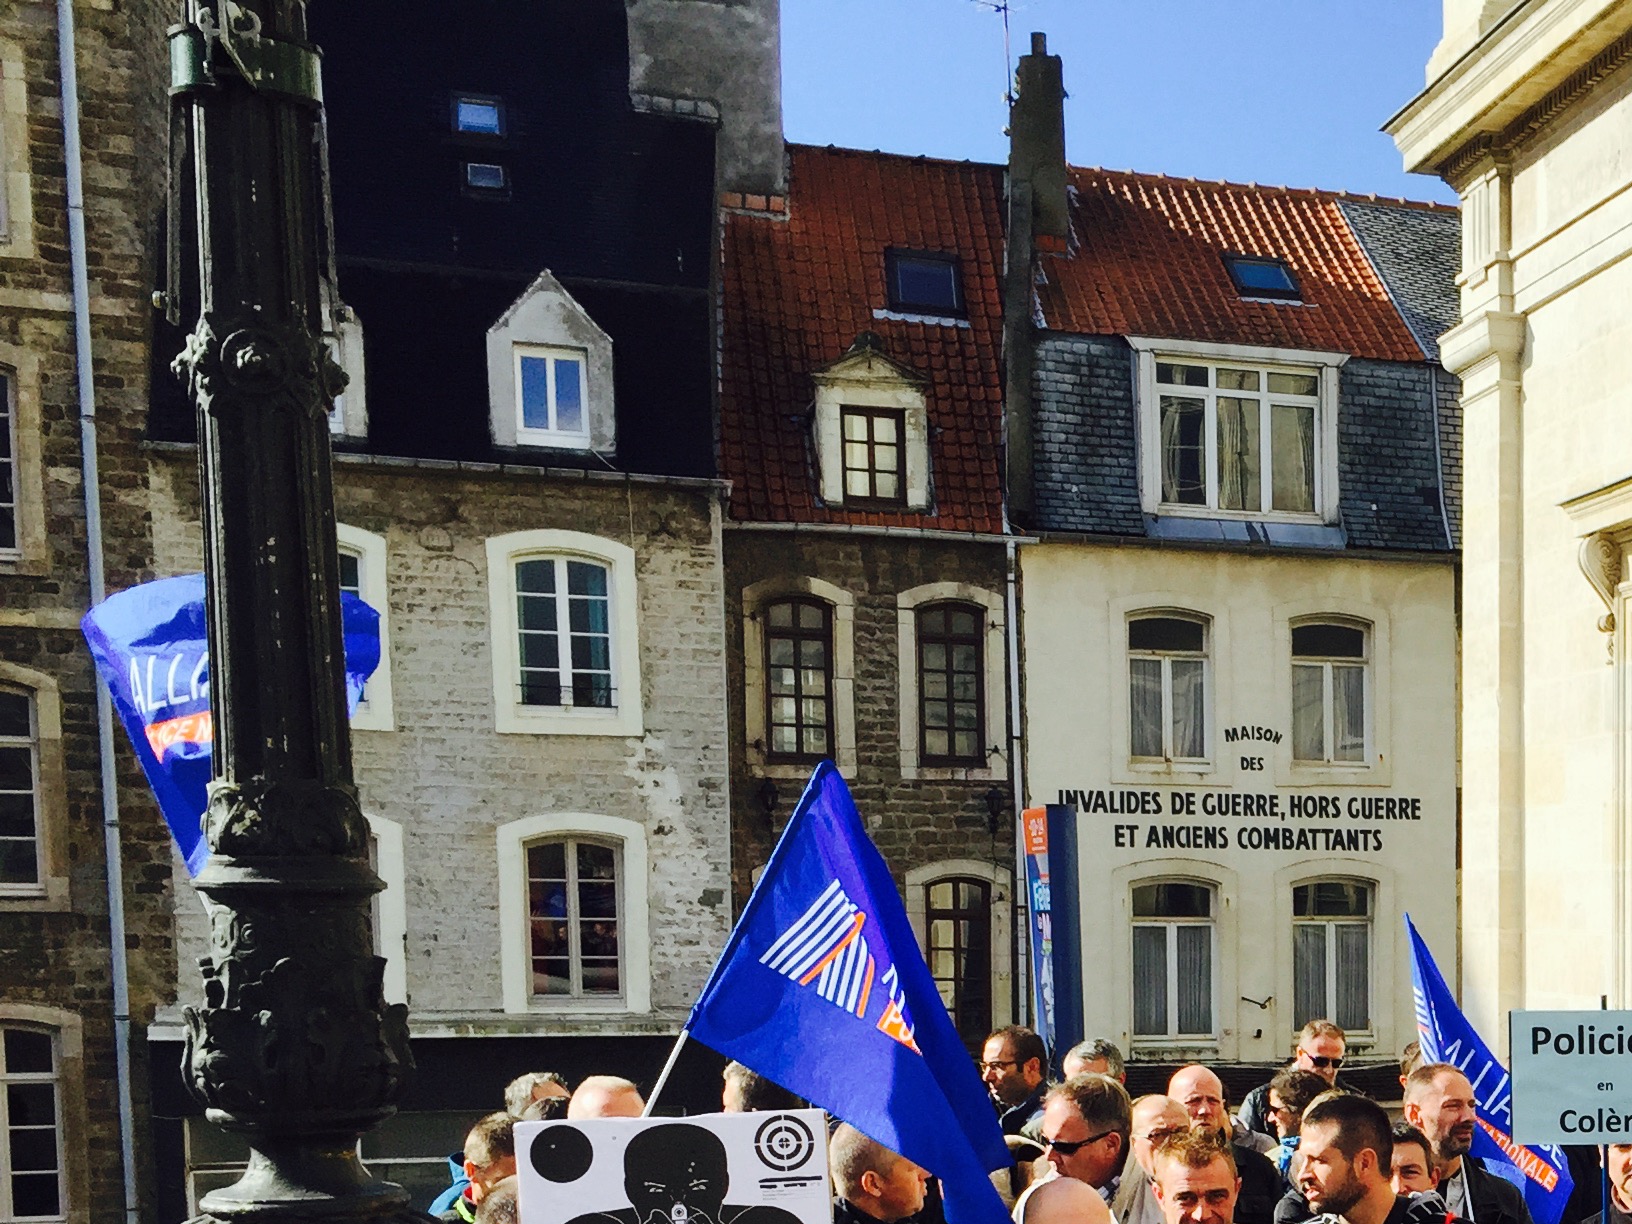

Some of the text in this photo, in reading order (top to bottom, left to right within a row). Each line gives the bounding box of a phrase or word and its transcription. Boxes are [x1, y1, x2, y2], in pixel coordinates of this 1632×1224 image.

[1224, 725, 1283, 745] MAISON
[1240, 756, 1264, 771] DES
[1058, 789, 1422, 822] INVALIDES DE GUERRE, HORS GUERRE
[1114, 824, 1384, 852] ET ANCIENS COMBATTANTS
[1597, 1080, 1614, 1092] en
[1481, 1122, 1557, 1192] ATIONALE
